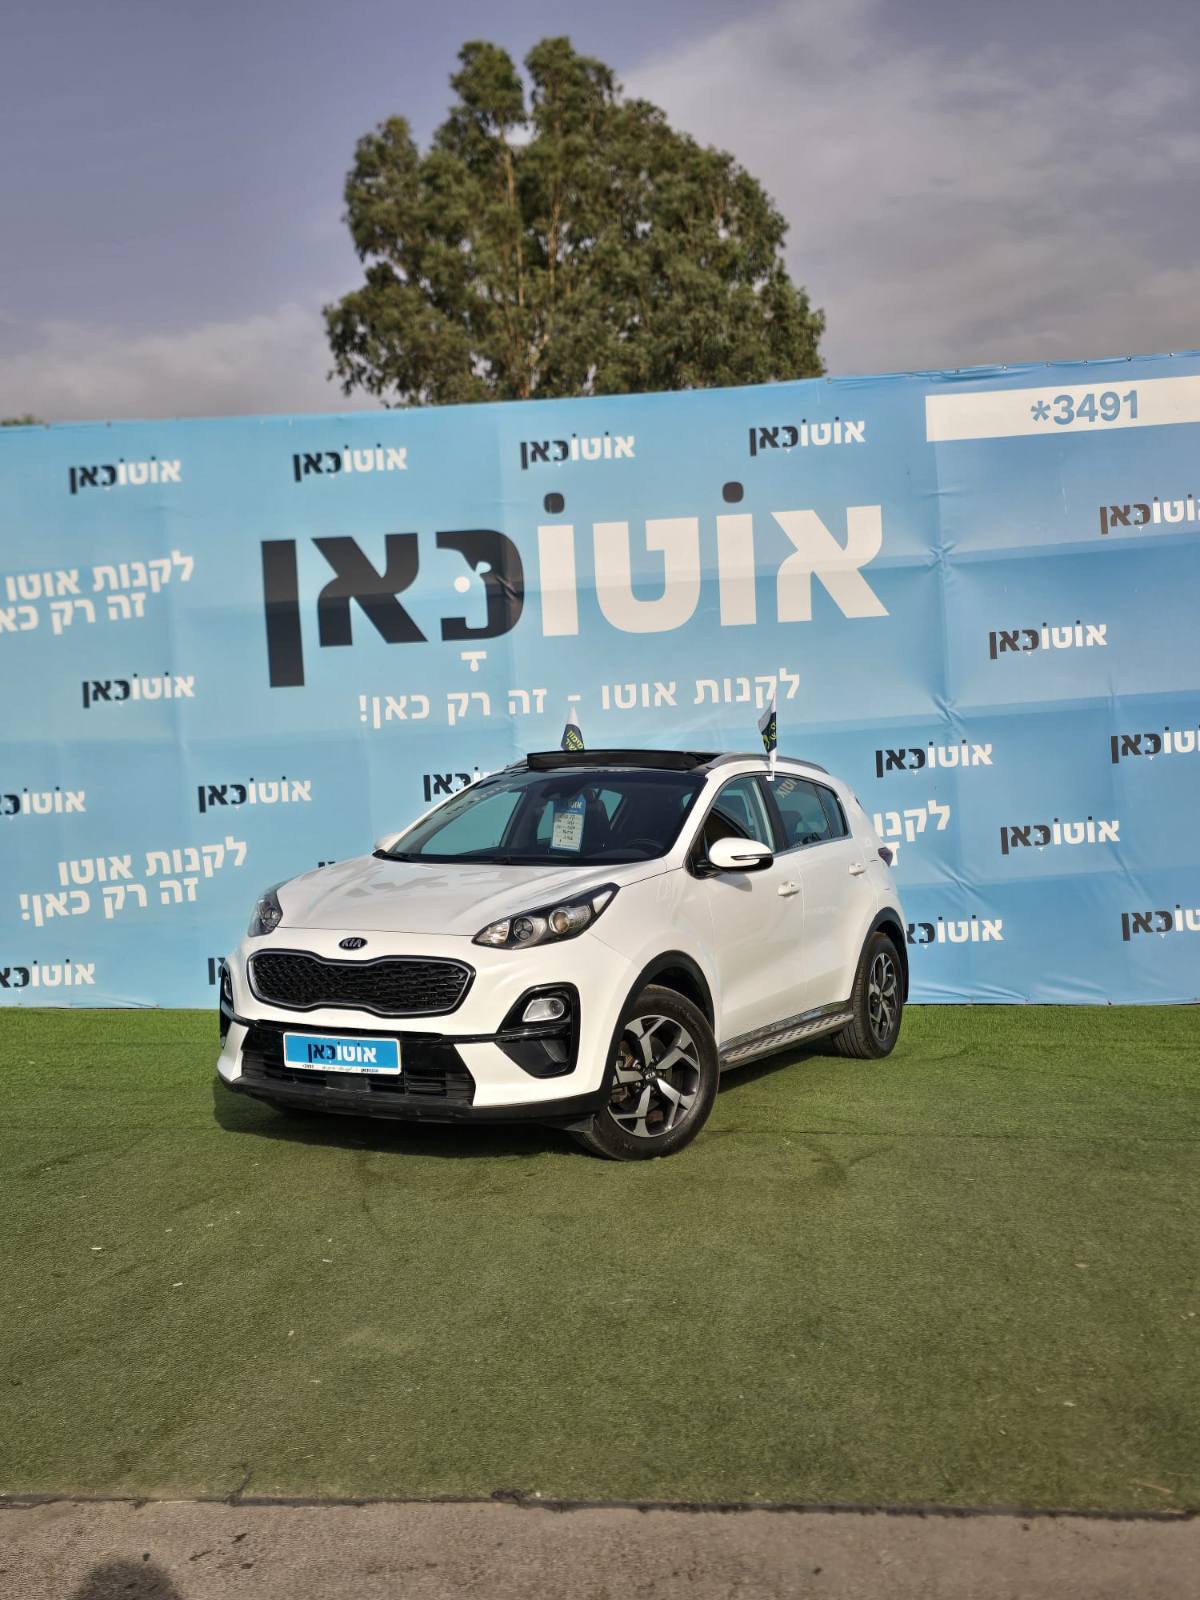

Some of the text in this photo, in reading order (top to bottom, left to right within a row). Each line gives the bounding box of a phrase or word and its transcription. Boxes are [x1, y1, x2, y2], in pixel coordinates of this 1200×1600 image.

[5, 549, 194, 602] לקנות אוטו
[50, 598, 96, 636] רק
[106, 591, 146, 621] זה
[508, 688, 547, 715] זה
[601, 681, 678, 710] אוטו
[693, 667, 800, 709] לקנות
[358, 694, 430, 729] כאן!
[447, 691, 491, 726] רק
[58, 835, 247, 887] לקנות אוטו
[19, 876, 199, 928] זה רק כאן!
[341, 938, 361, 948] KIA
